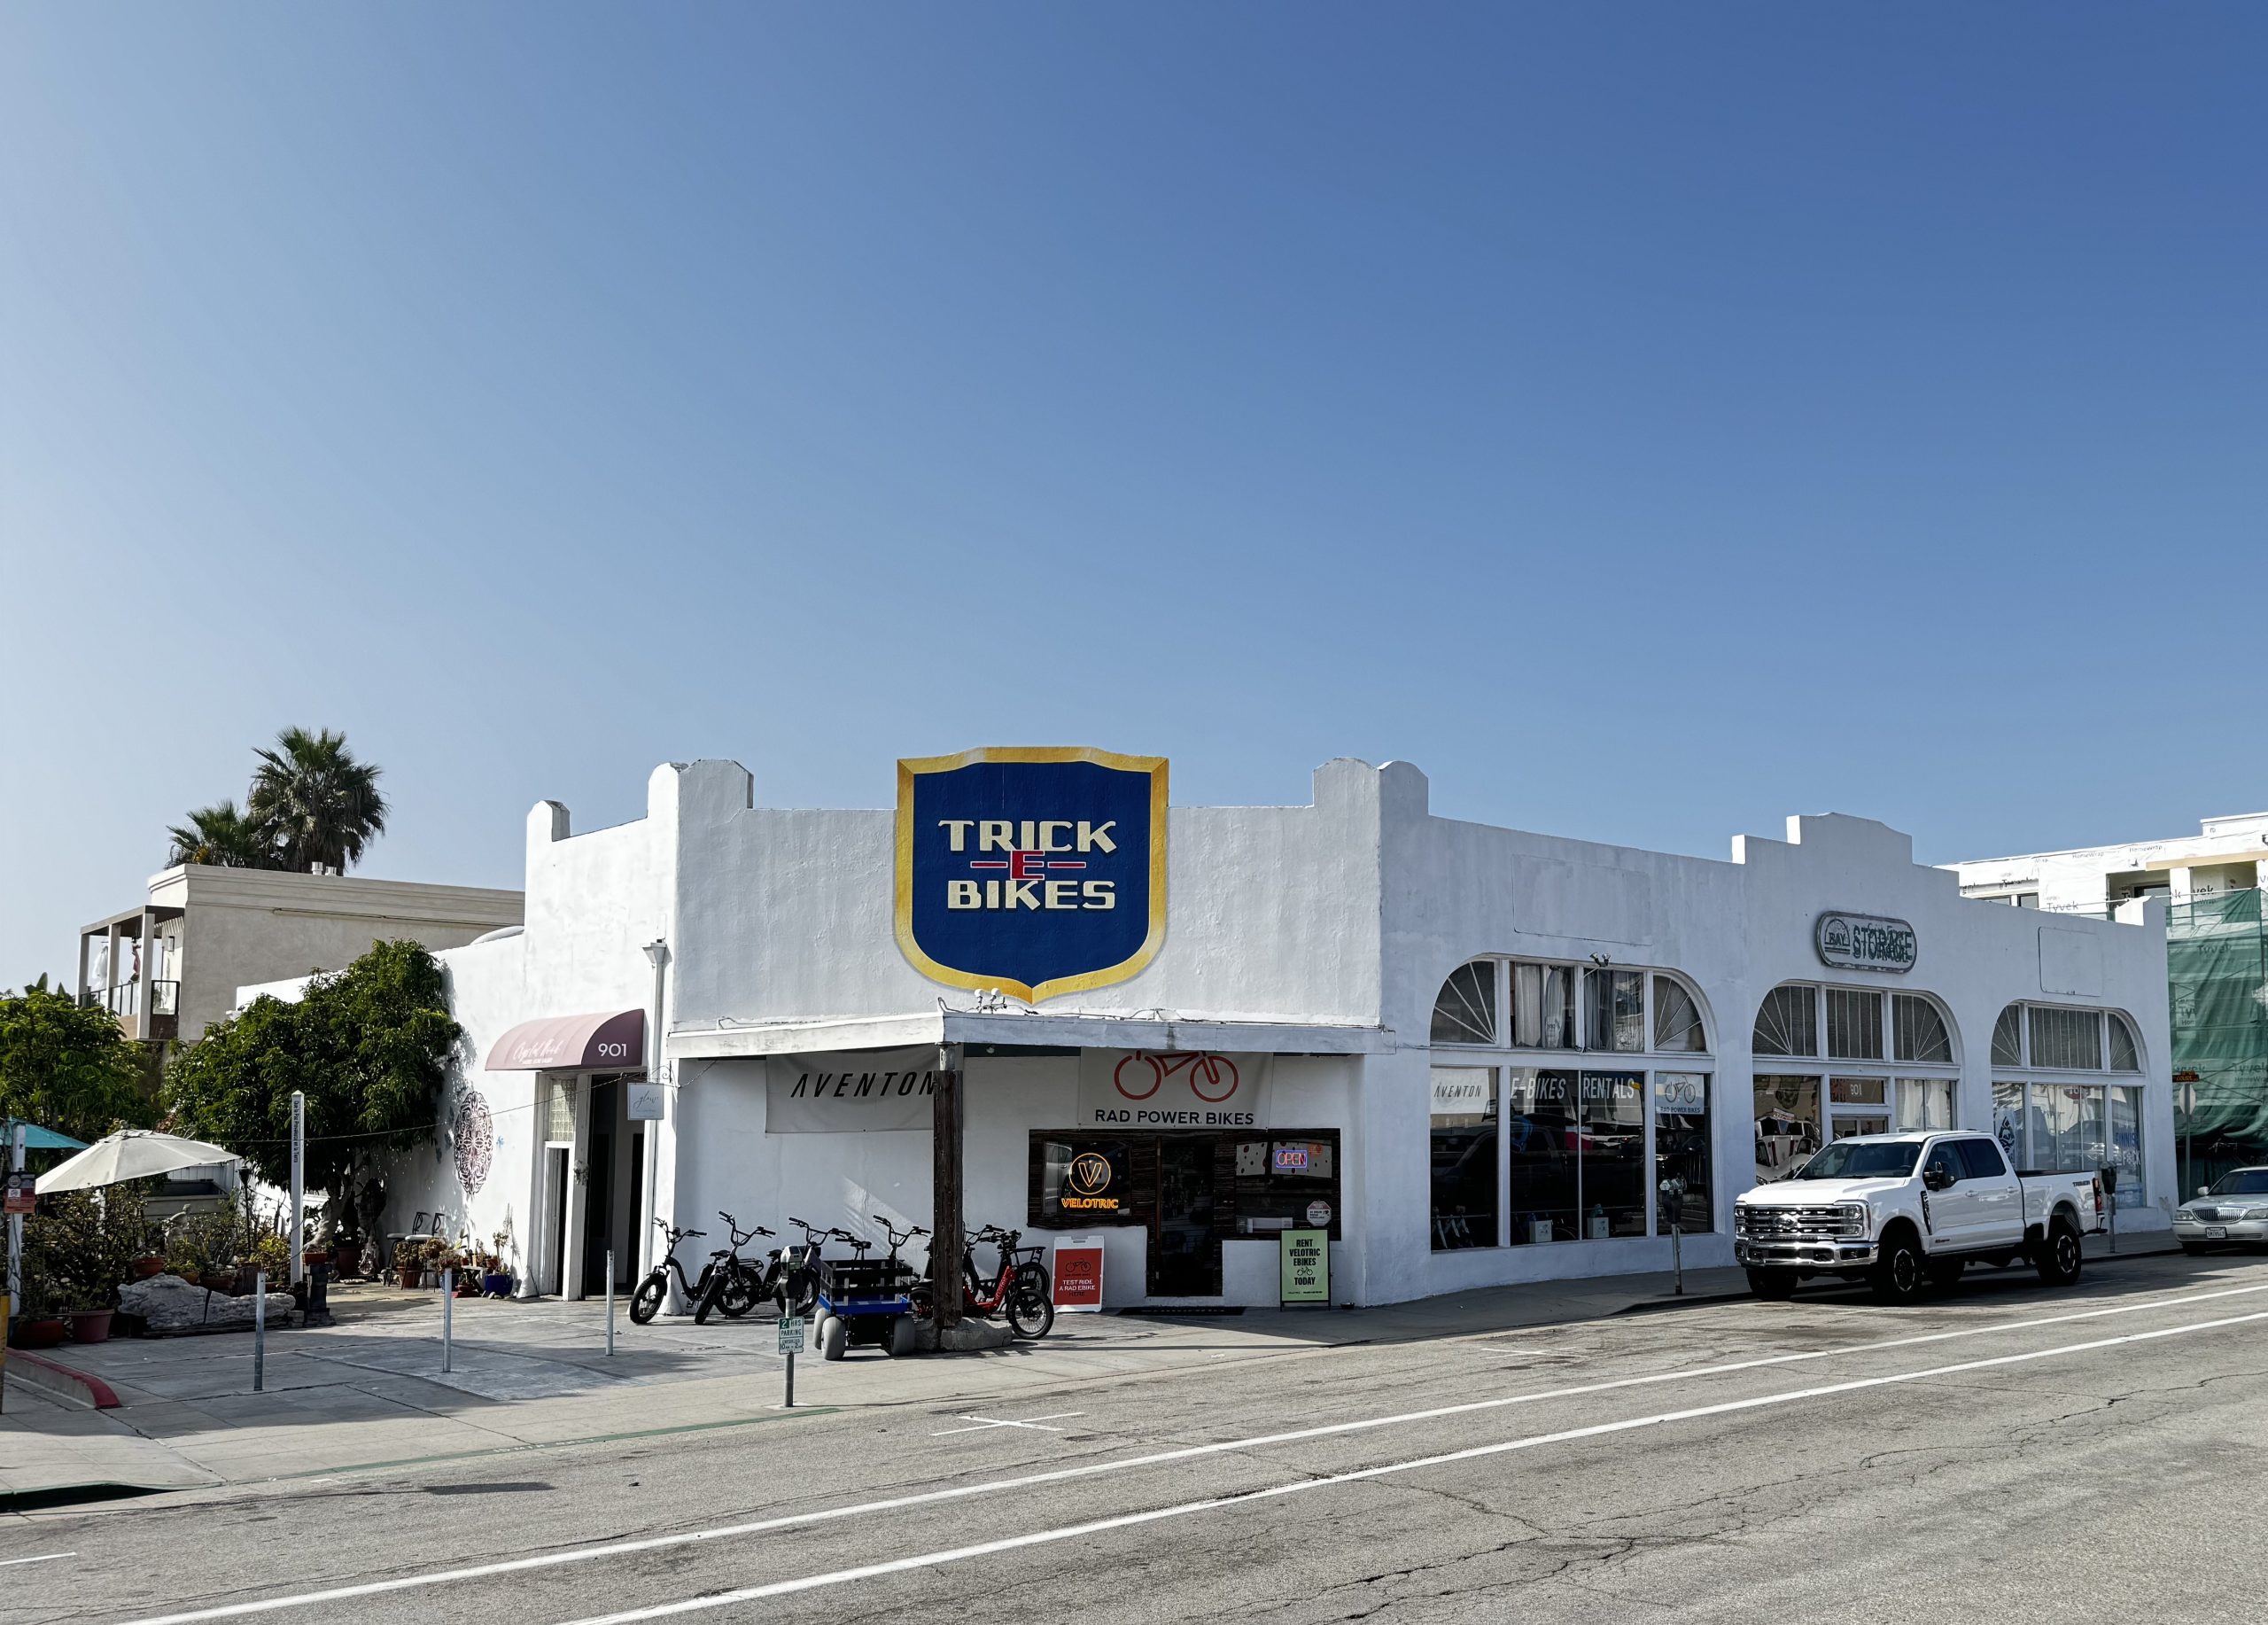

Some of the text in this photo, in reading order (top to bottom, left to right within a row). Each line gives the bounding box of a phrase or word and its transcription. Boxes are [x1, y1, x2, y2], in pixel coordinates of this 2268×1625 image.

[938, 820, 1117, 853] TRICK
[1010, 850, 1045, 881] E
[947, 880, 1115, 911] BIKES
[598, 1043, 627, 1057] 901
[790, 1071, 936, 1098] AVENTON
[1433, 1085, 1482, 1098] AVENTON
[1510, 1077, 1635, 1100] E-BIKES RENTALS
[1095, 1109, 1254, 1125] RAD POWER BIKES
[1277, 1152, 1307, 1166] OPEN
[1061, 1197, 1119, 1209] VELOTRIC
[1296, 1239, 1313, 1248] RENT
[1289, 1248, 1321, 1256] VELOTRIC
[1293, 1257, 1317, 1266] EBIKES
[1294, 1277, 1317, 1286] TODAY
[781, 1319, 788, 1328] 2
